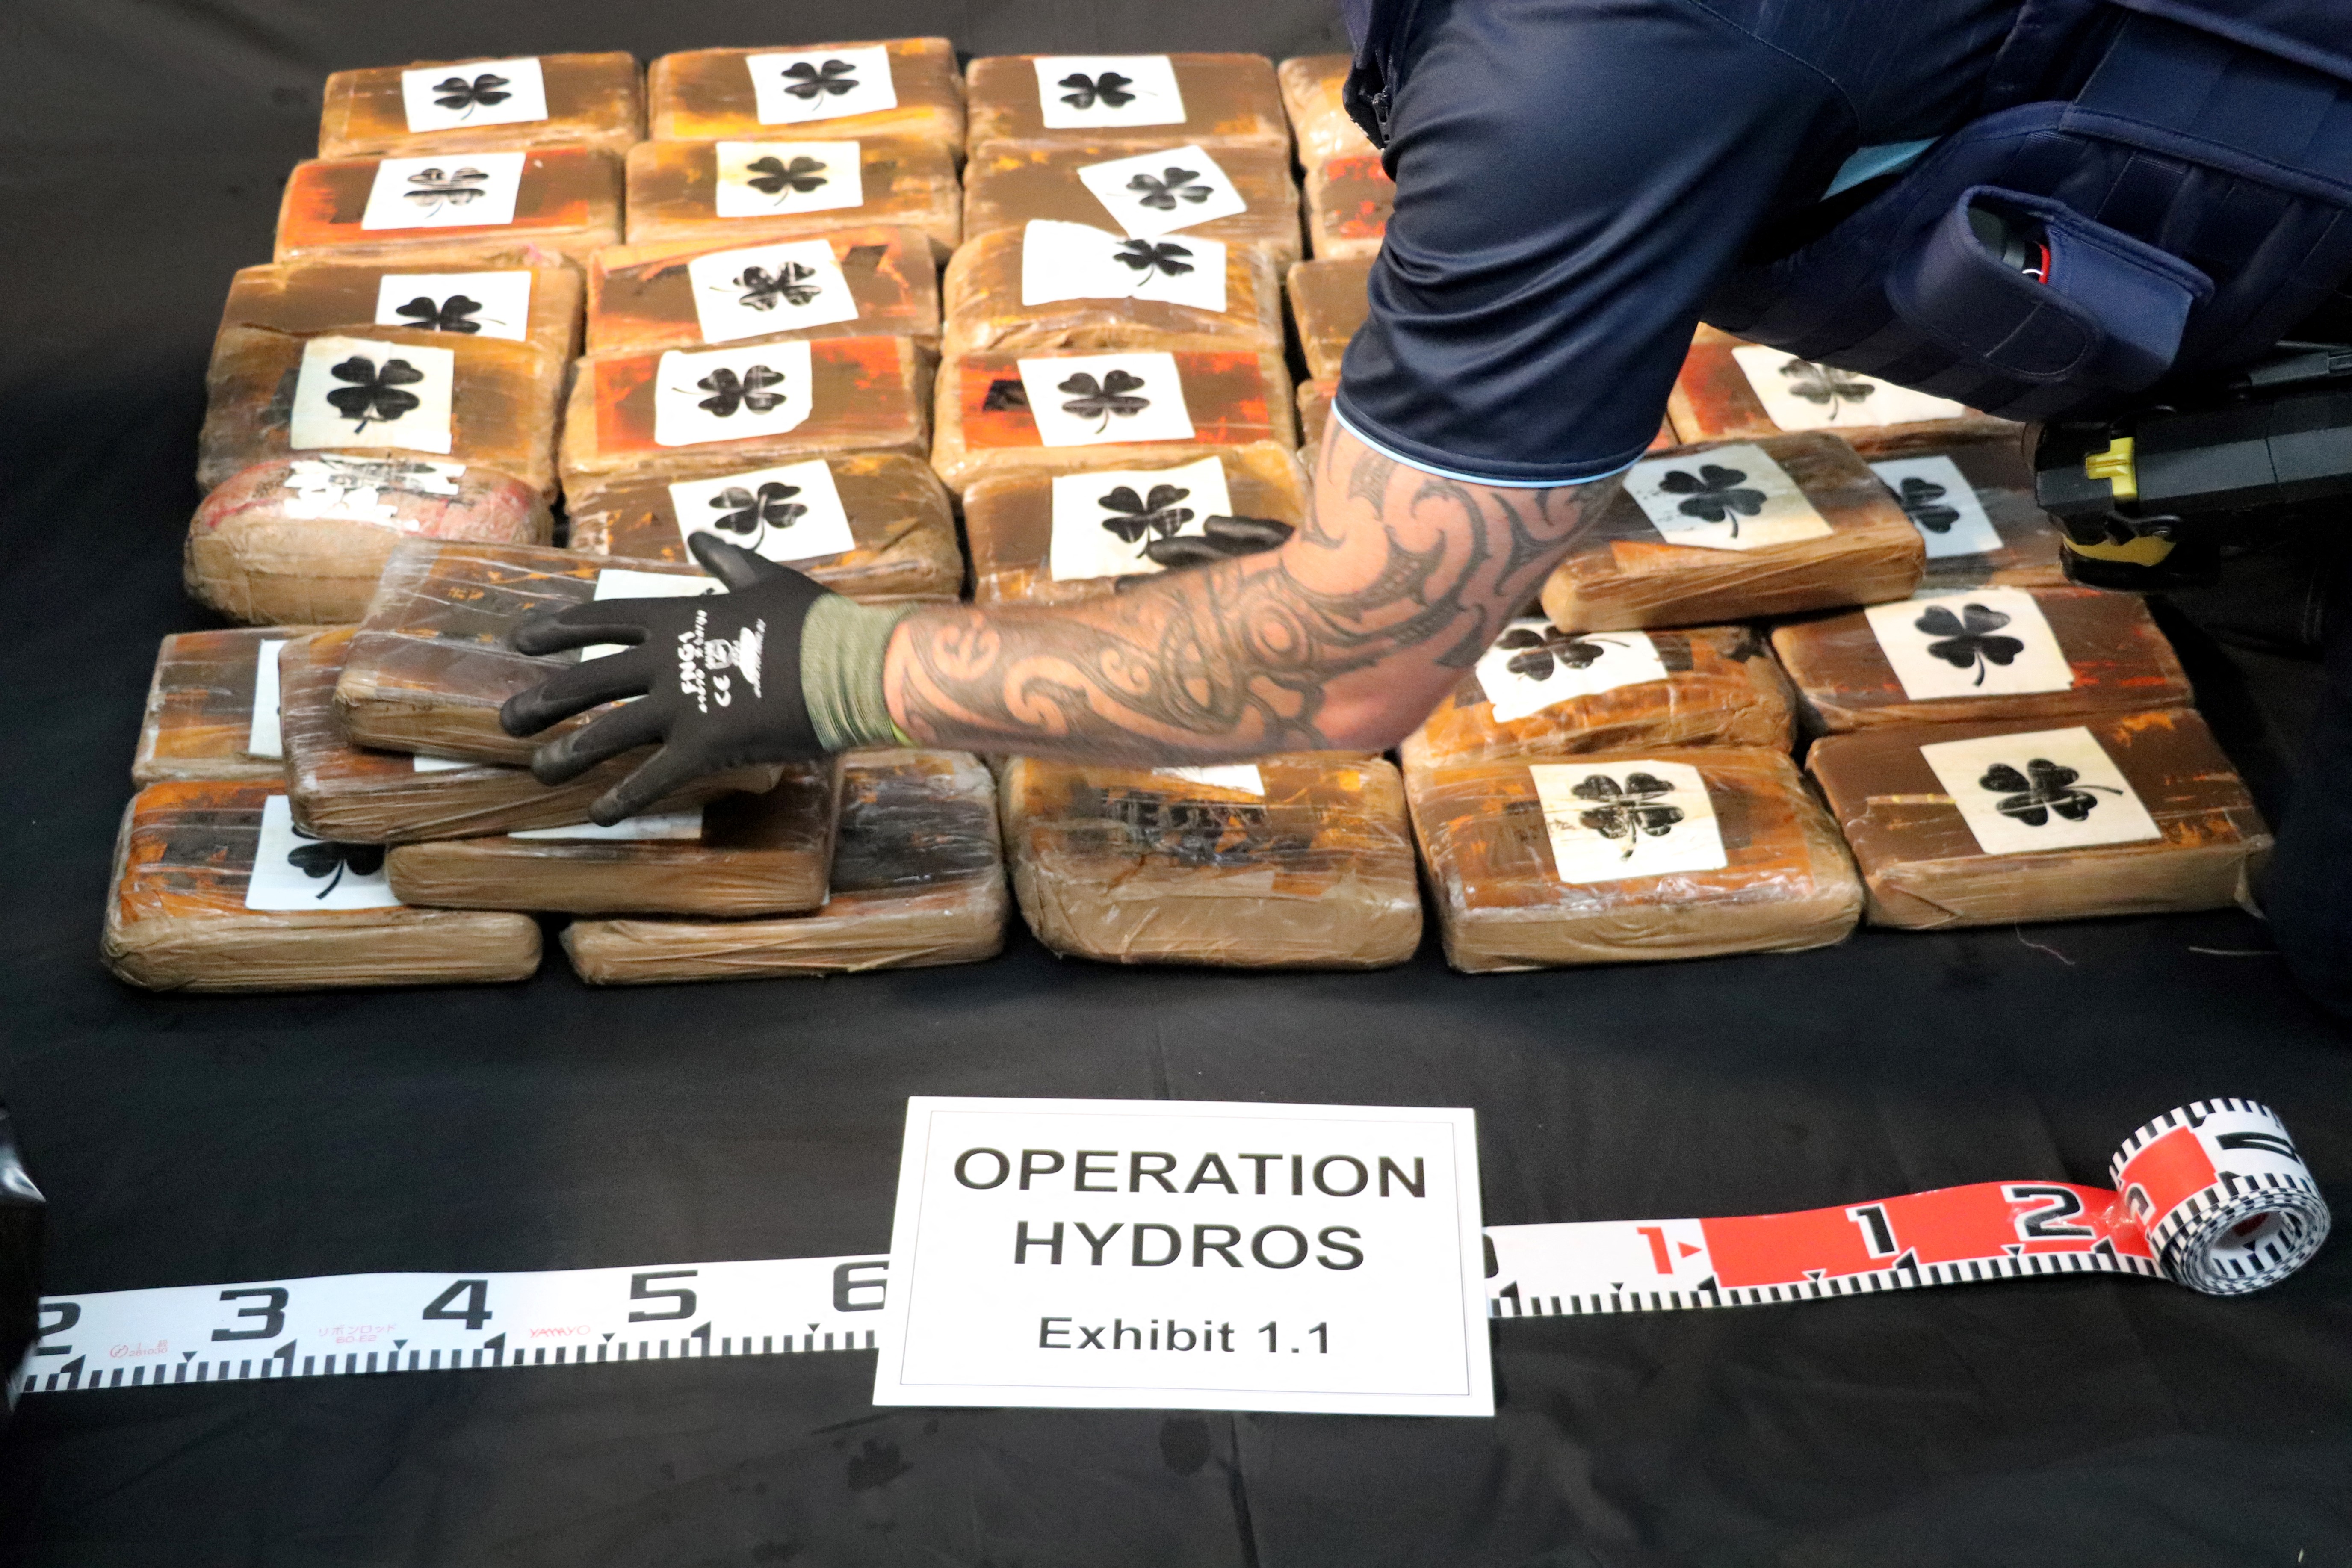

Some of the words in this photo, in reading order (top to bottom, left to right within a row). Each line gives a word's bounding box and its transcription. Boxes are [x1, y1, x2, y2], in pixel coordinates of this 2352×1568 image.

[954, 1148, 1426, 1198] OPERATION
[1850, 1204, 1898, 1256] 1
[2003, 1185, 2096, 1240] 2
[1014, 1221, 1364, 1271] HYDROS
[211, 1287, 289, 1342] 3
[422, 1280, 493, 1329] 4
[628, 1270, 698, 1323] 5
[833, 1260, 890, 1312] 6
[529, 1325, 591, 1338] YAMAYO
[1039, 1316, 1235, 1352] Exhibit
[1259, 1321, 1328, 1354] 1.1
